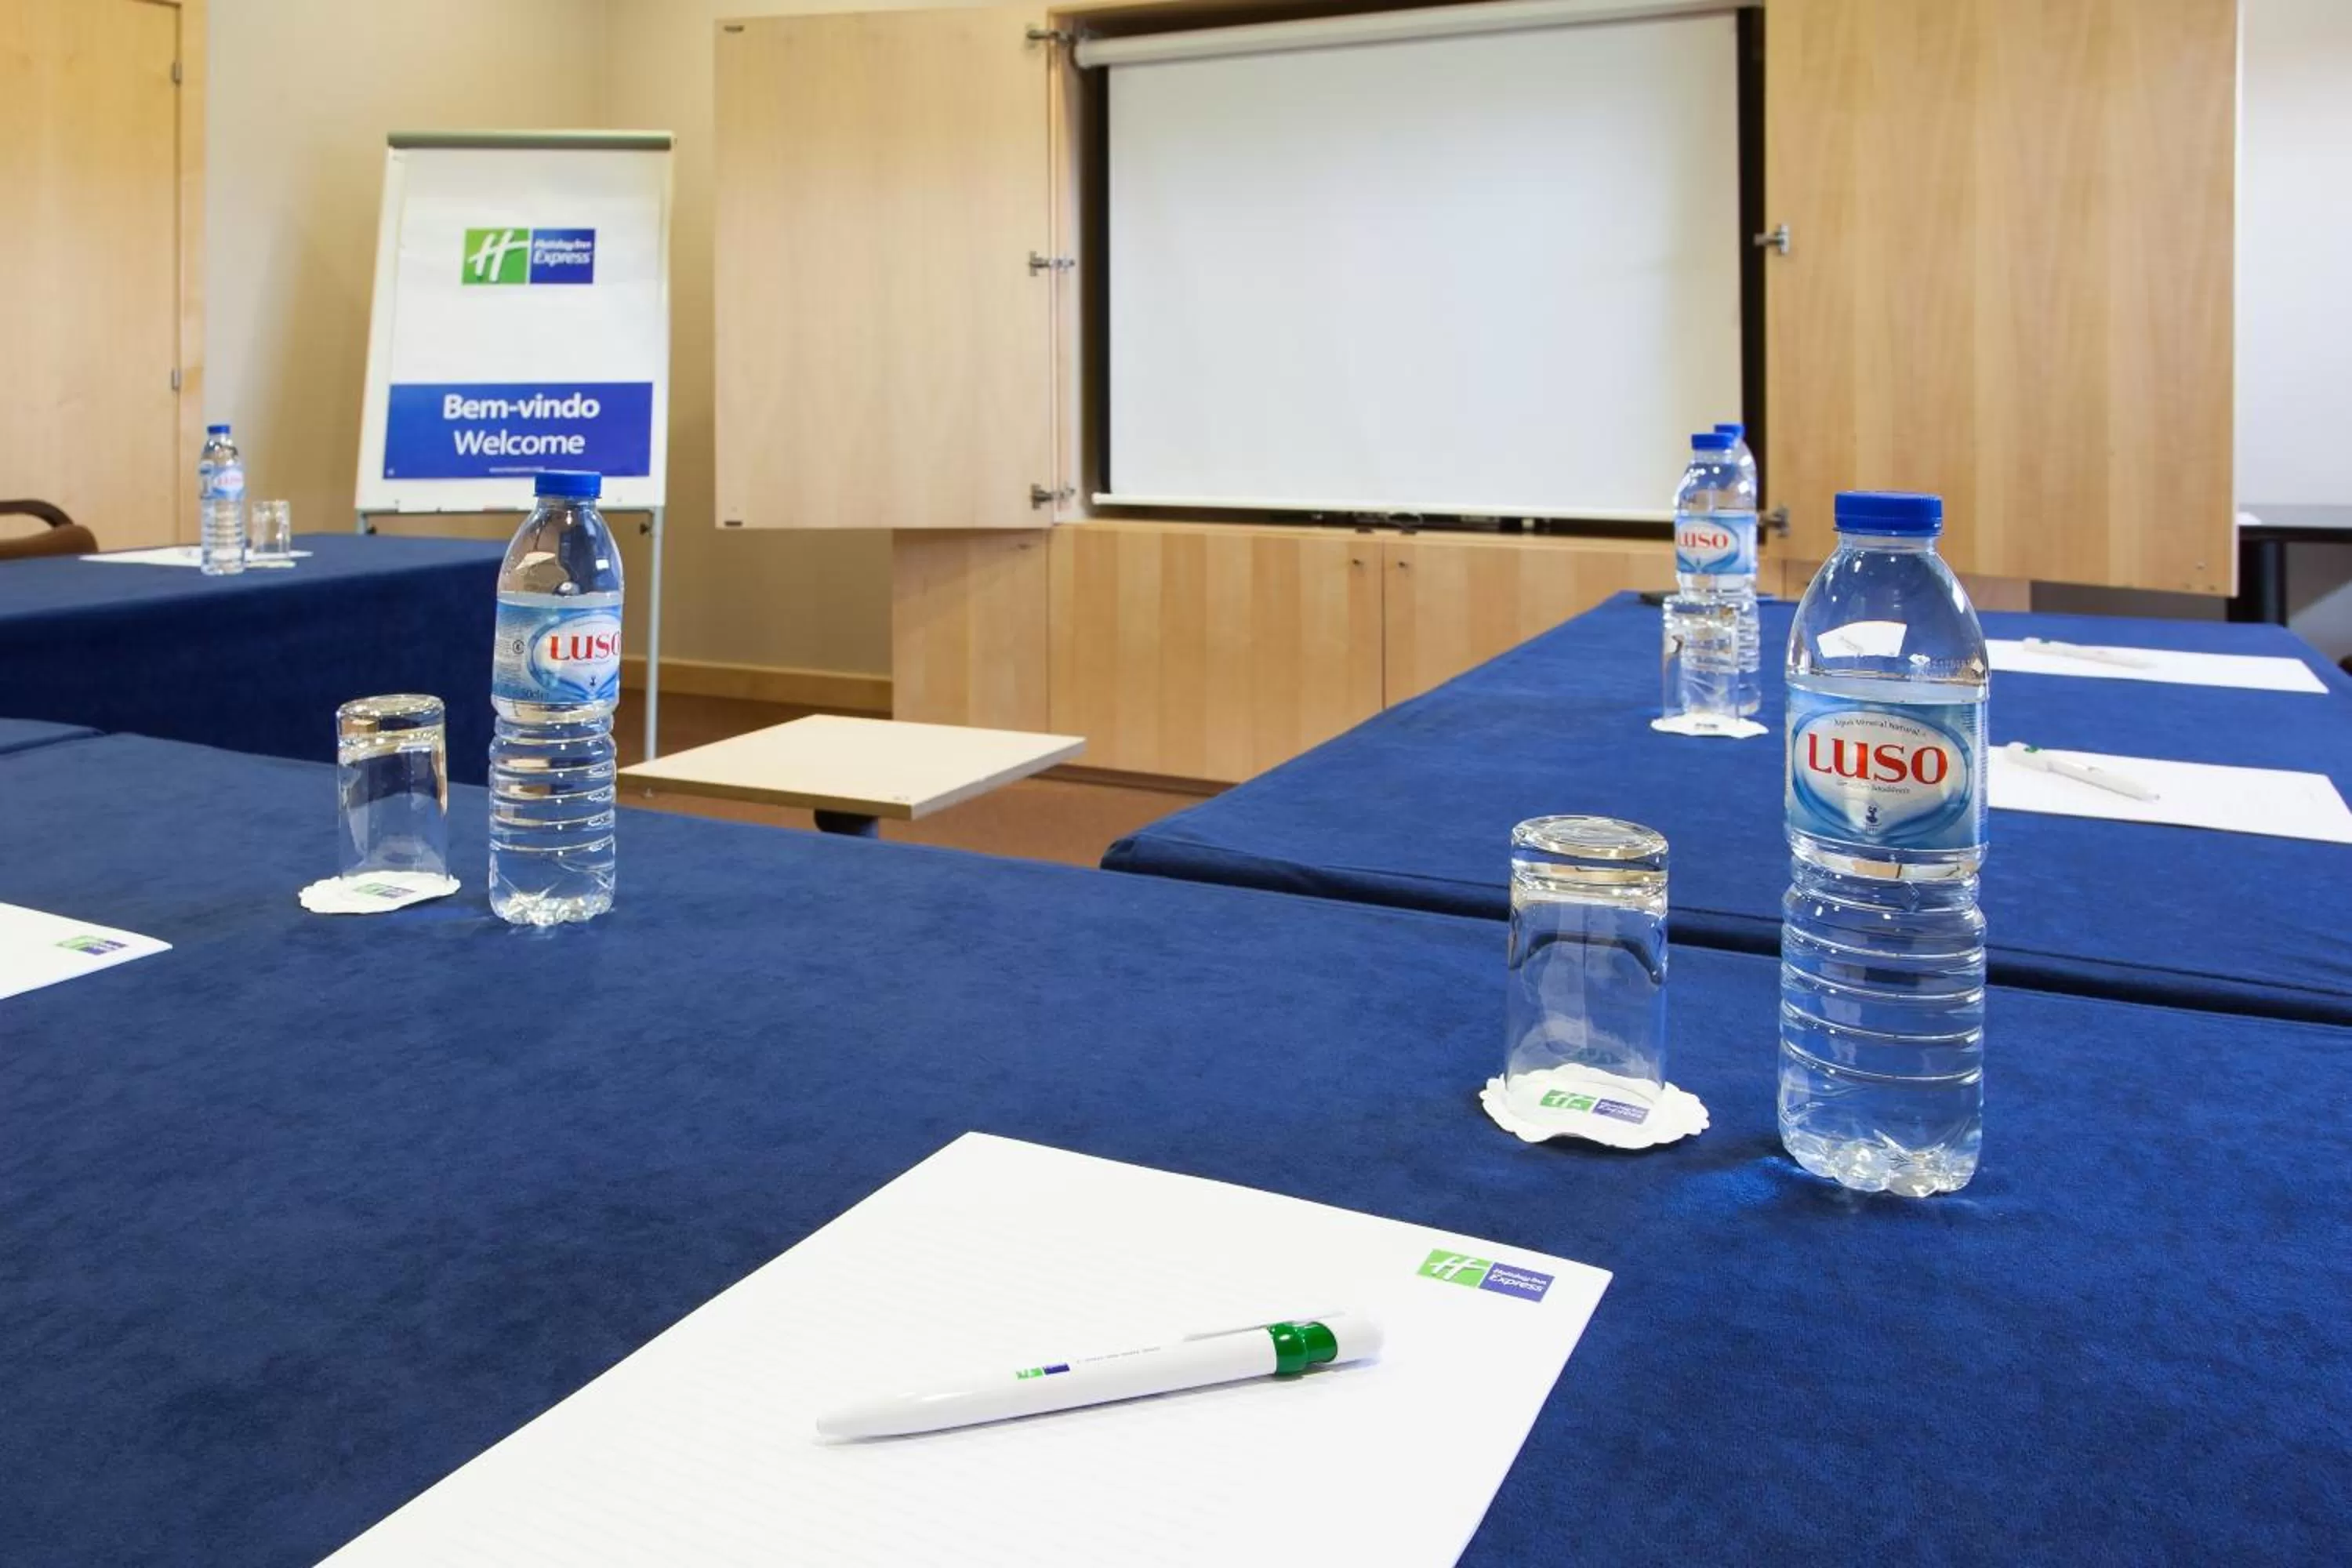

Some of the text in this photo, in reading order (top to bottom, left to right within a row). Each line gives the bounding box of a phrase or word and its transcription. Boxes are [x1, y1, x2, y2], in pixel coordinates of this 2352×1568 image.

[533, 249, 591, 267] Express
[443, 393, 601, 419] Bem-vindo
[454, 429, 586, 456] Welcome
[1808, 733, 1947, 785] LUSO
[1489, 1274, 1544, 1292] Express
